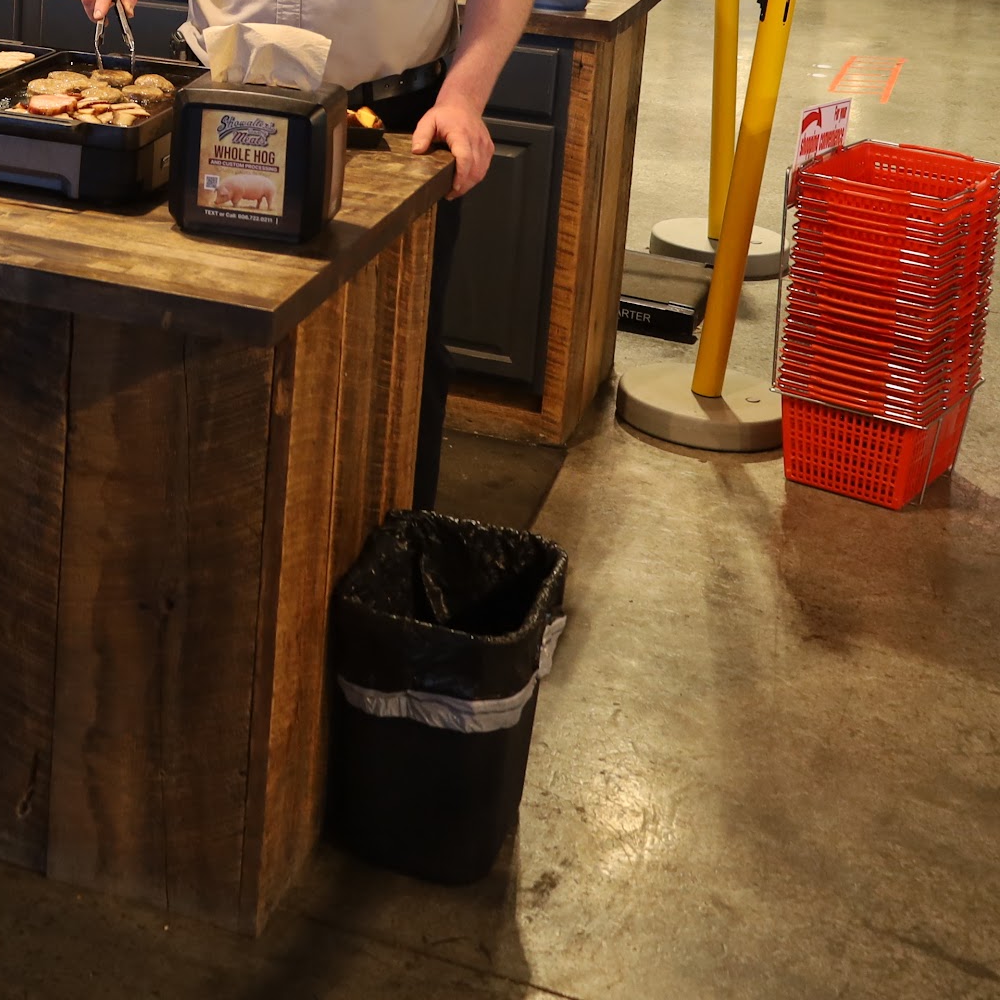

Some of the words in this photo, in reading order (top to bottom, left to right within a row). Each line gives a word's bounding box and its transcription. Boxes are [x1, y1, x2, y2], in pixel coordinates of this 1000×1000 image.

[214, 145, 251, 162] WHOLE
[253, 149, 276, 165] HOG
[222, 160, 245, 168] CUSTOM
[245, 163, 278, 172] PROCESSING
